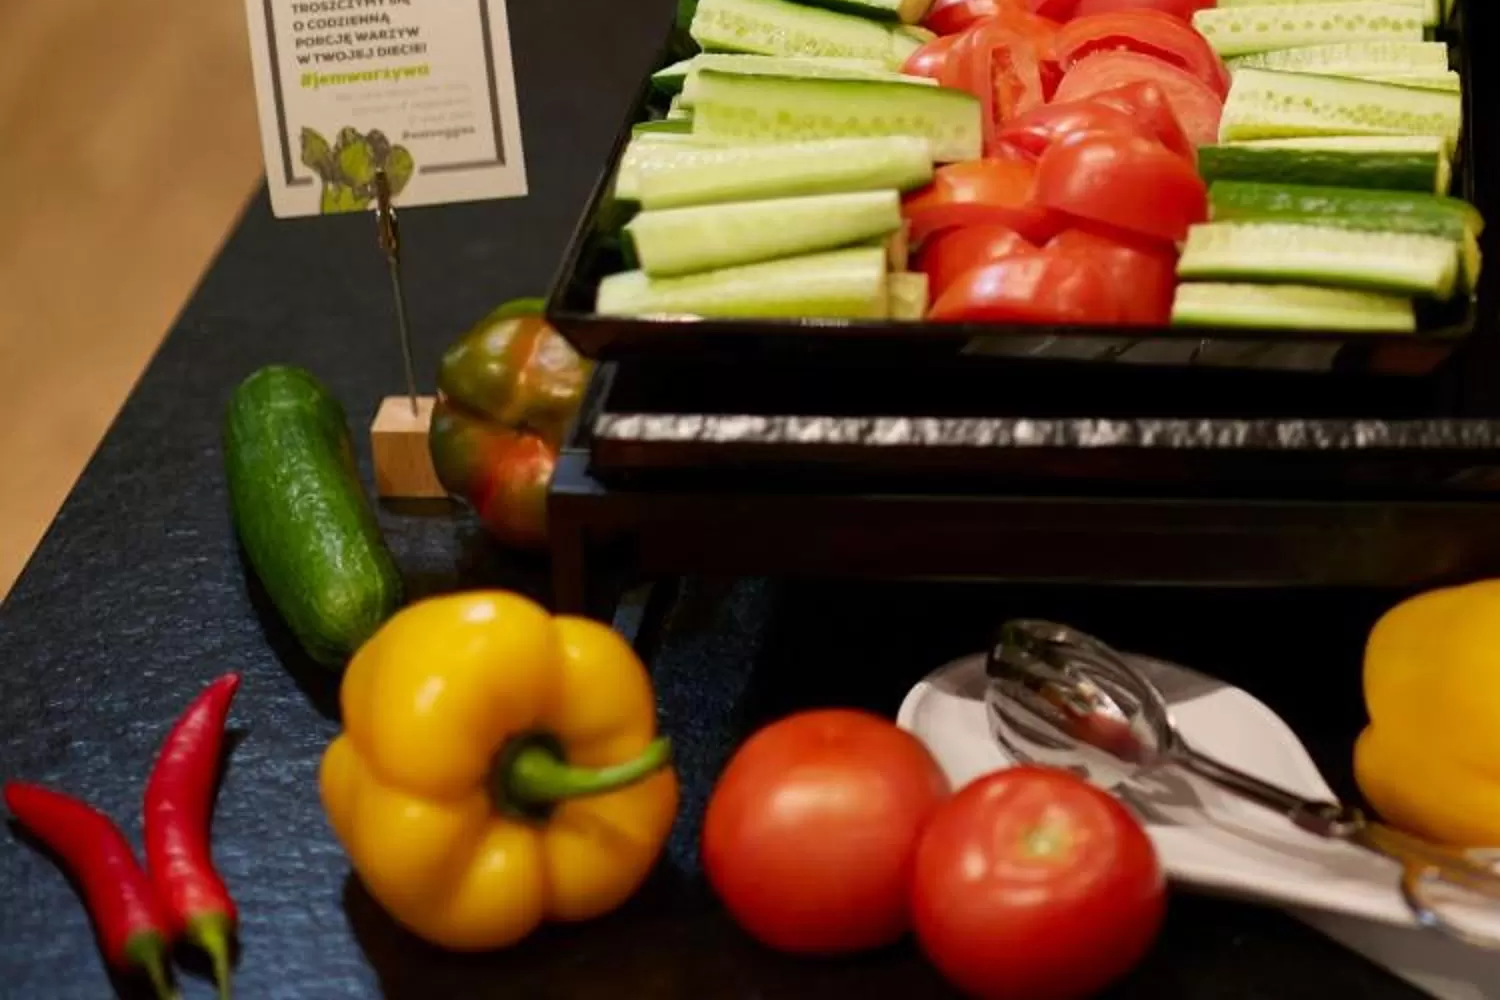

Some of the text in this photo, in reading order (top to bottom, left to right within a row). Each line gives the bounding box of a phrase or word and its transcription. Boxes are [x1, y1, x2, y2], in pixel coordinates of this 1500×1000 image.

[293, 20, 305, 32] O
[354, 26, 420, 42] WARZYW
[296, 53, 311, 65] W
[313, 48, 375, 64] TWOJEJ
